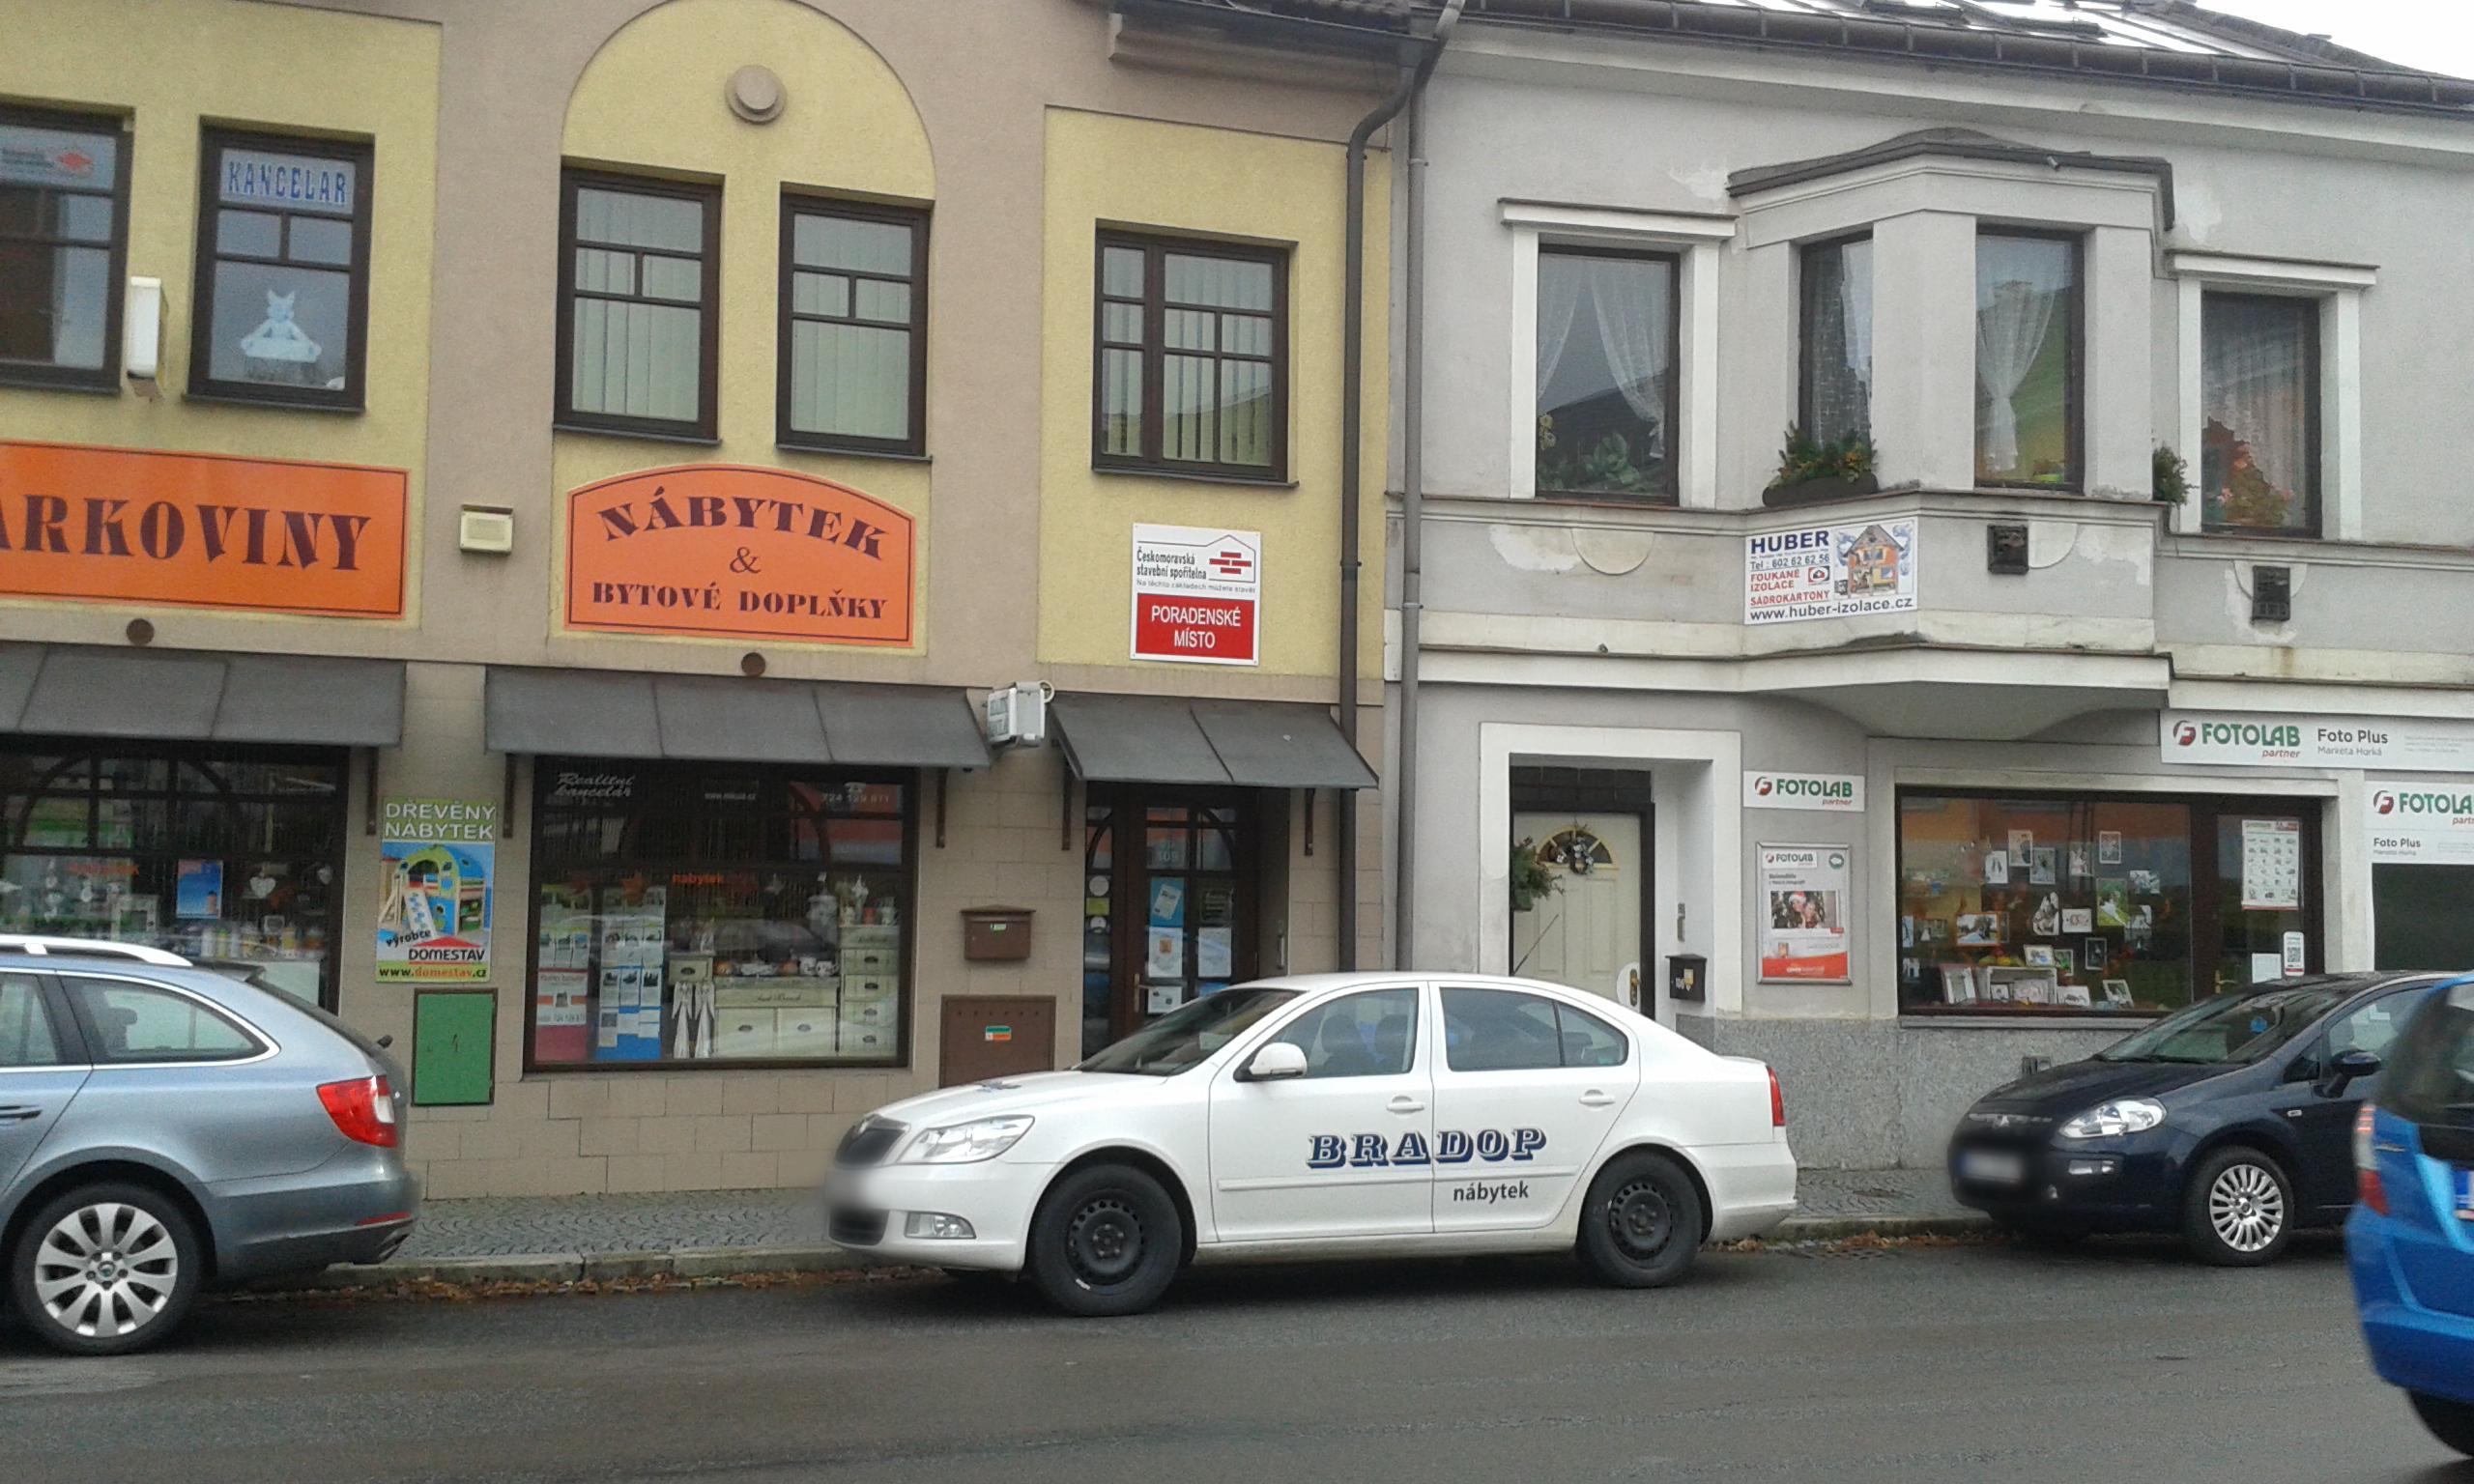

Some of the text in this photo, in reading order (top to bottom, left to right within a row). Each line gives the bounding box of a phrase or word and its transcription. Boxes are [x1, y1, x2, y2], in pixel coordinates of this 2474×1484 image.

[0, 495, 371, 571] RKOVINY
[597, 486, 889, 560] NÁBYTEK
[1751, 530, 1829, 554] HUBER
[729, 547, 762, 574] &
[1136, 546, 1195, 565] Českomoravská
[1771, 557, 1788, 568] 602
[1791, 556, 1802, 566] 62
[1804, 555, 1816, 564] 62
[1819, 553, 1830, 562] 56
[1136, 563, 1168, 578] stavební
[1750, 580, 1795, 592] IZOLACE
[592, 582, 887, 619] BYTOVÉ DOPLŇKY
[1750, 598, 1913, 620] www.huber-izolace.cz
[1151, 605, 1241, 626] PORADENSKÉ
[1174, 627, 1216, 648] MÍSTO
[2201, 723, 2300, 747] FOTOLAB
[2317, 728, 2353, 742] Foto
[2357, 729, 2389, 744] Plus
[2261, 749, 2300, 757] partner
[1776, 779, 1853, 797] FOTOLAB
[385, 819, 493, 840] NÁBYTEK
[2373, 838, 2421, 847] Foto Plus
[1775, 853, 1814, 863] FOTOLAB
[385, 929, 431, 947] výrobce
[409, 949, 485, 961] DOMESTAV
[1306, 1127, 1547, 1169] BRADOP
[1453, 1181, 1529, 1204] nábytek
